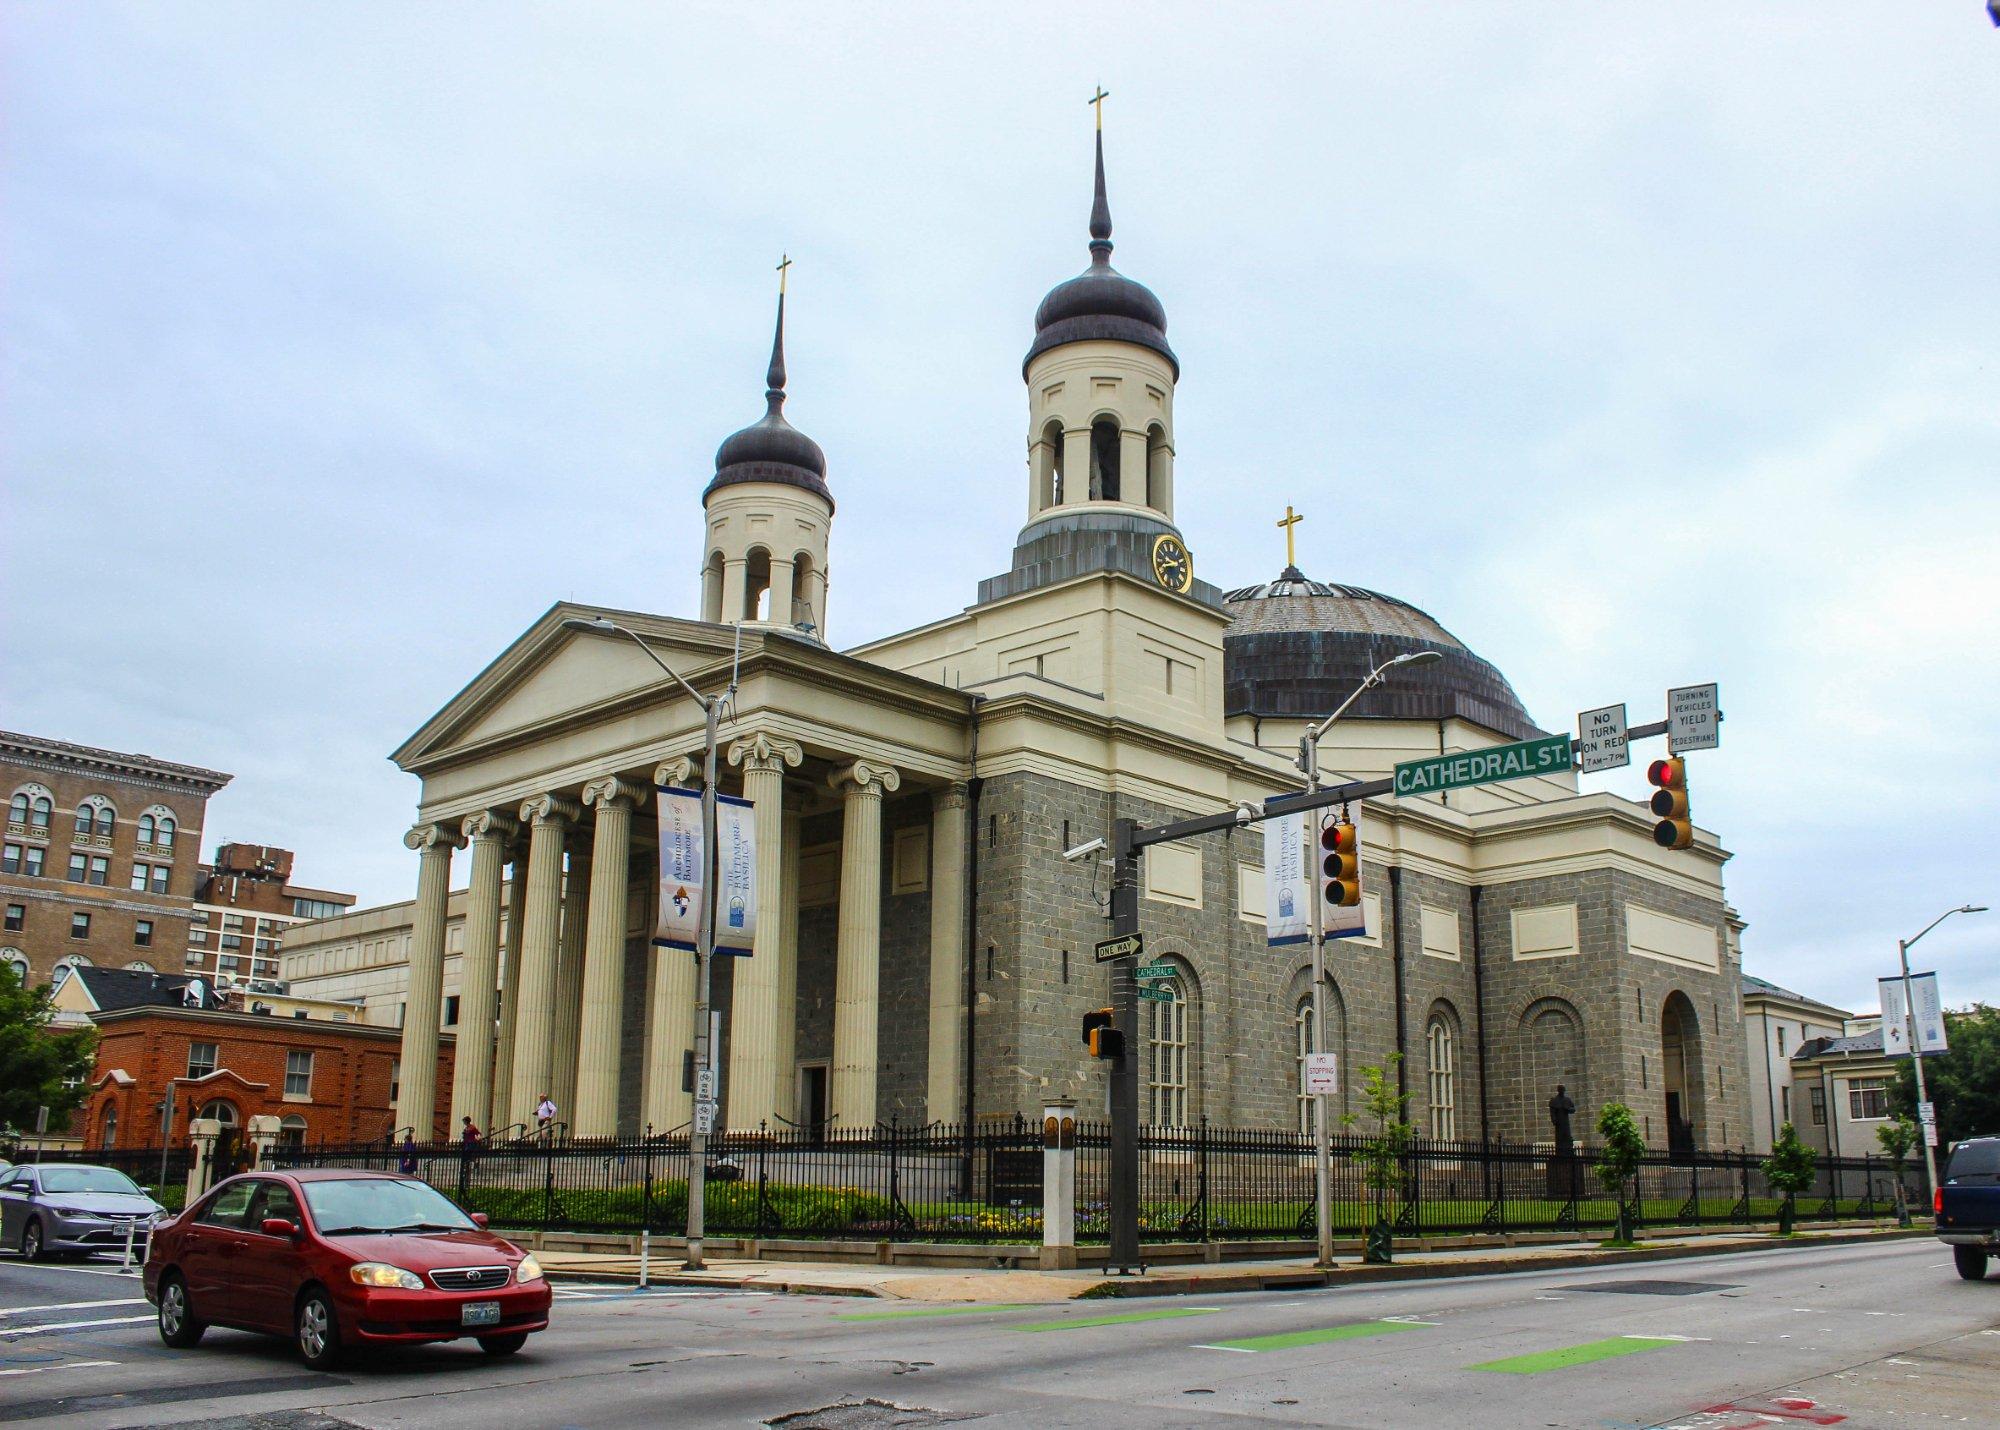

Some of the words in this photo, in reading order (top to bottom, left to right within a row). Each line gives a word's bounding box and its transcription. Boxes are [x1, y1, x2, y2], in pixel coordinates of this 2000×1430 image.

[1676, 691, 1709, 701] TURNING
[1675, 702, 1712, 713] VEHICLES
[1594, 713, 1610, 725] NO
[1680, 714, 1707, 725] YIELD
[1590, 725, 1617, 738] TURN
[1583, 741, 1598, 753] ON
[1604, 736, 1625, 748] RED
[1672, 734, 1715, 746] PEDESTRIANS
[1397, 749, 1536, 792] CATHEDRAL
[1537, 745, 1568, 766] ST.
[733, 819, 742, 889] BALTIMORE
[1281, 818, 1289, 884] BALTIMORE
[1290, 831, 1298, 879] BASILICA
[742, 839, 750, 890] BASILICA
[1099, 946, 1114, 957] ONE
[1117, 942, 1132, 952] WAY
[1137, 967, 1167, 977] CATHEDRAL
